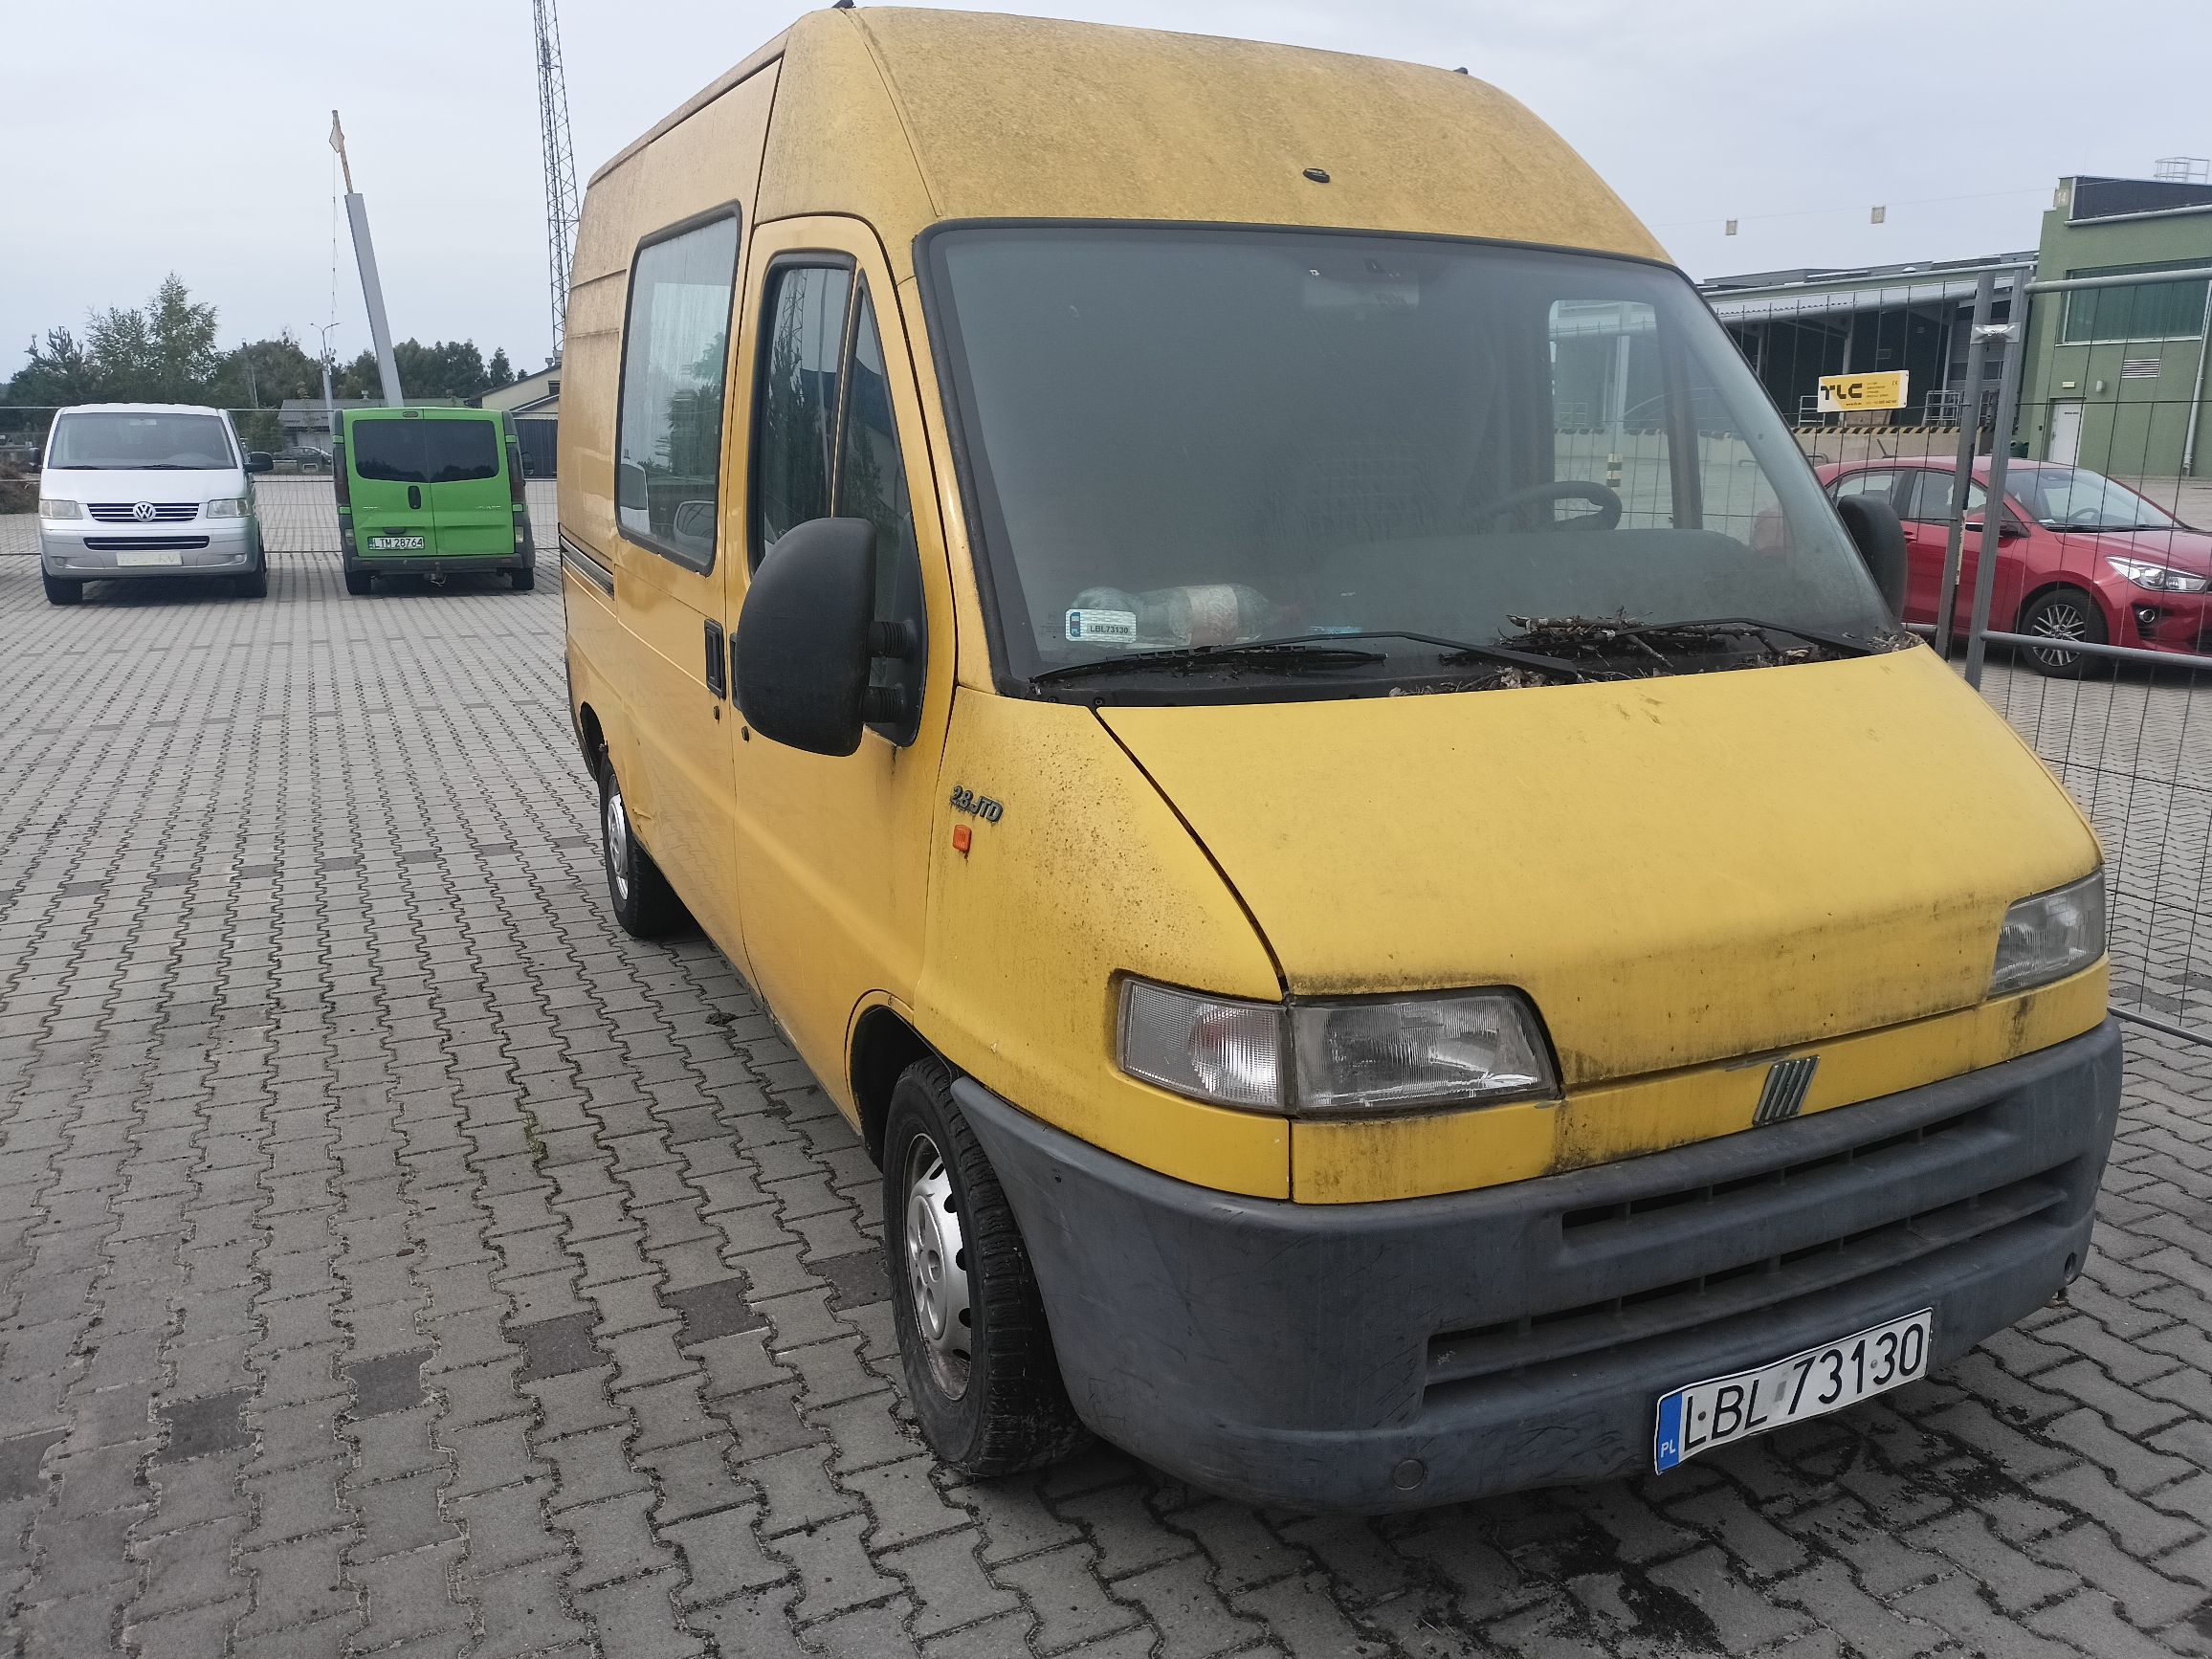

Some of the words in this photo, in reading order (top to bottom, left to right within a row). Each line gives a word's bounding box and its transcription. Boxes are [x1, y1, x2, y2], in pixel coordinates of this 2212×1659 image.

[1821, 383, 1863, 400] TLC
[135, 503, 154, 520] VW
[373, 538, 392, 548] LTM
[394, 538, 423, 548] 28764
[1090, 625, 1129, 634] LBL73130
[1683, 1379, 1768, 1452] LBL
[1787, 1322, 1924, 1416] 73130
[1660, 1439, 1676, 1458] PL
